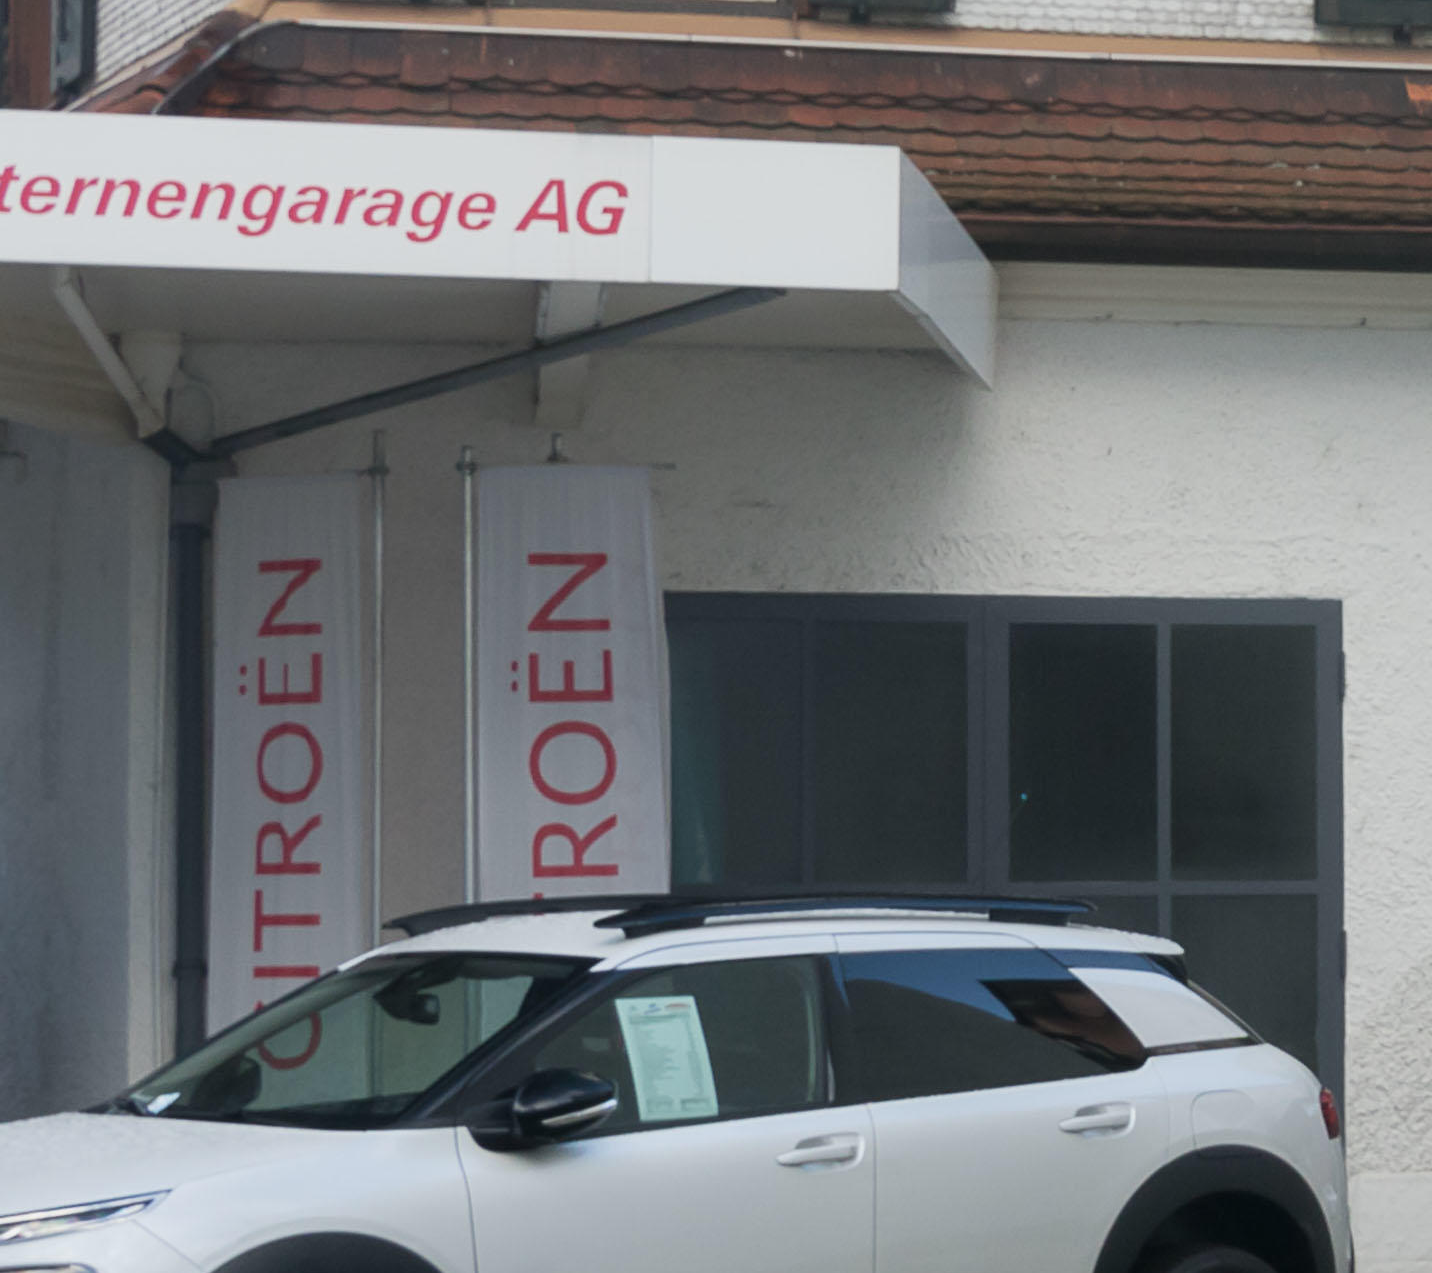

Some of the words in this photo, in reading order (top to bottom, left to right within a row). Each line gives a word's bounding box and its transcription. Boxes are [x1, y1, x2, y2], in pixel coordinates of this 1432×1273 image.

[514, 178, 630, 236] AG
[238, 556, 325, 1071] CITROËN
[511, 552, 619, 902] ROËN
